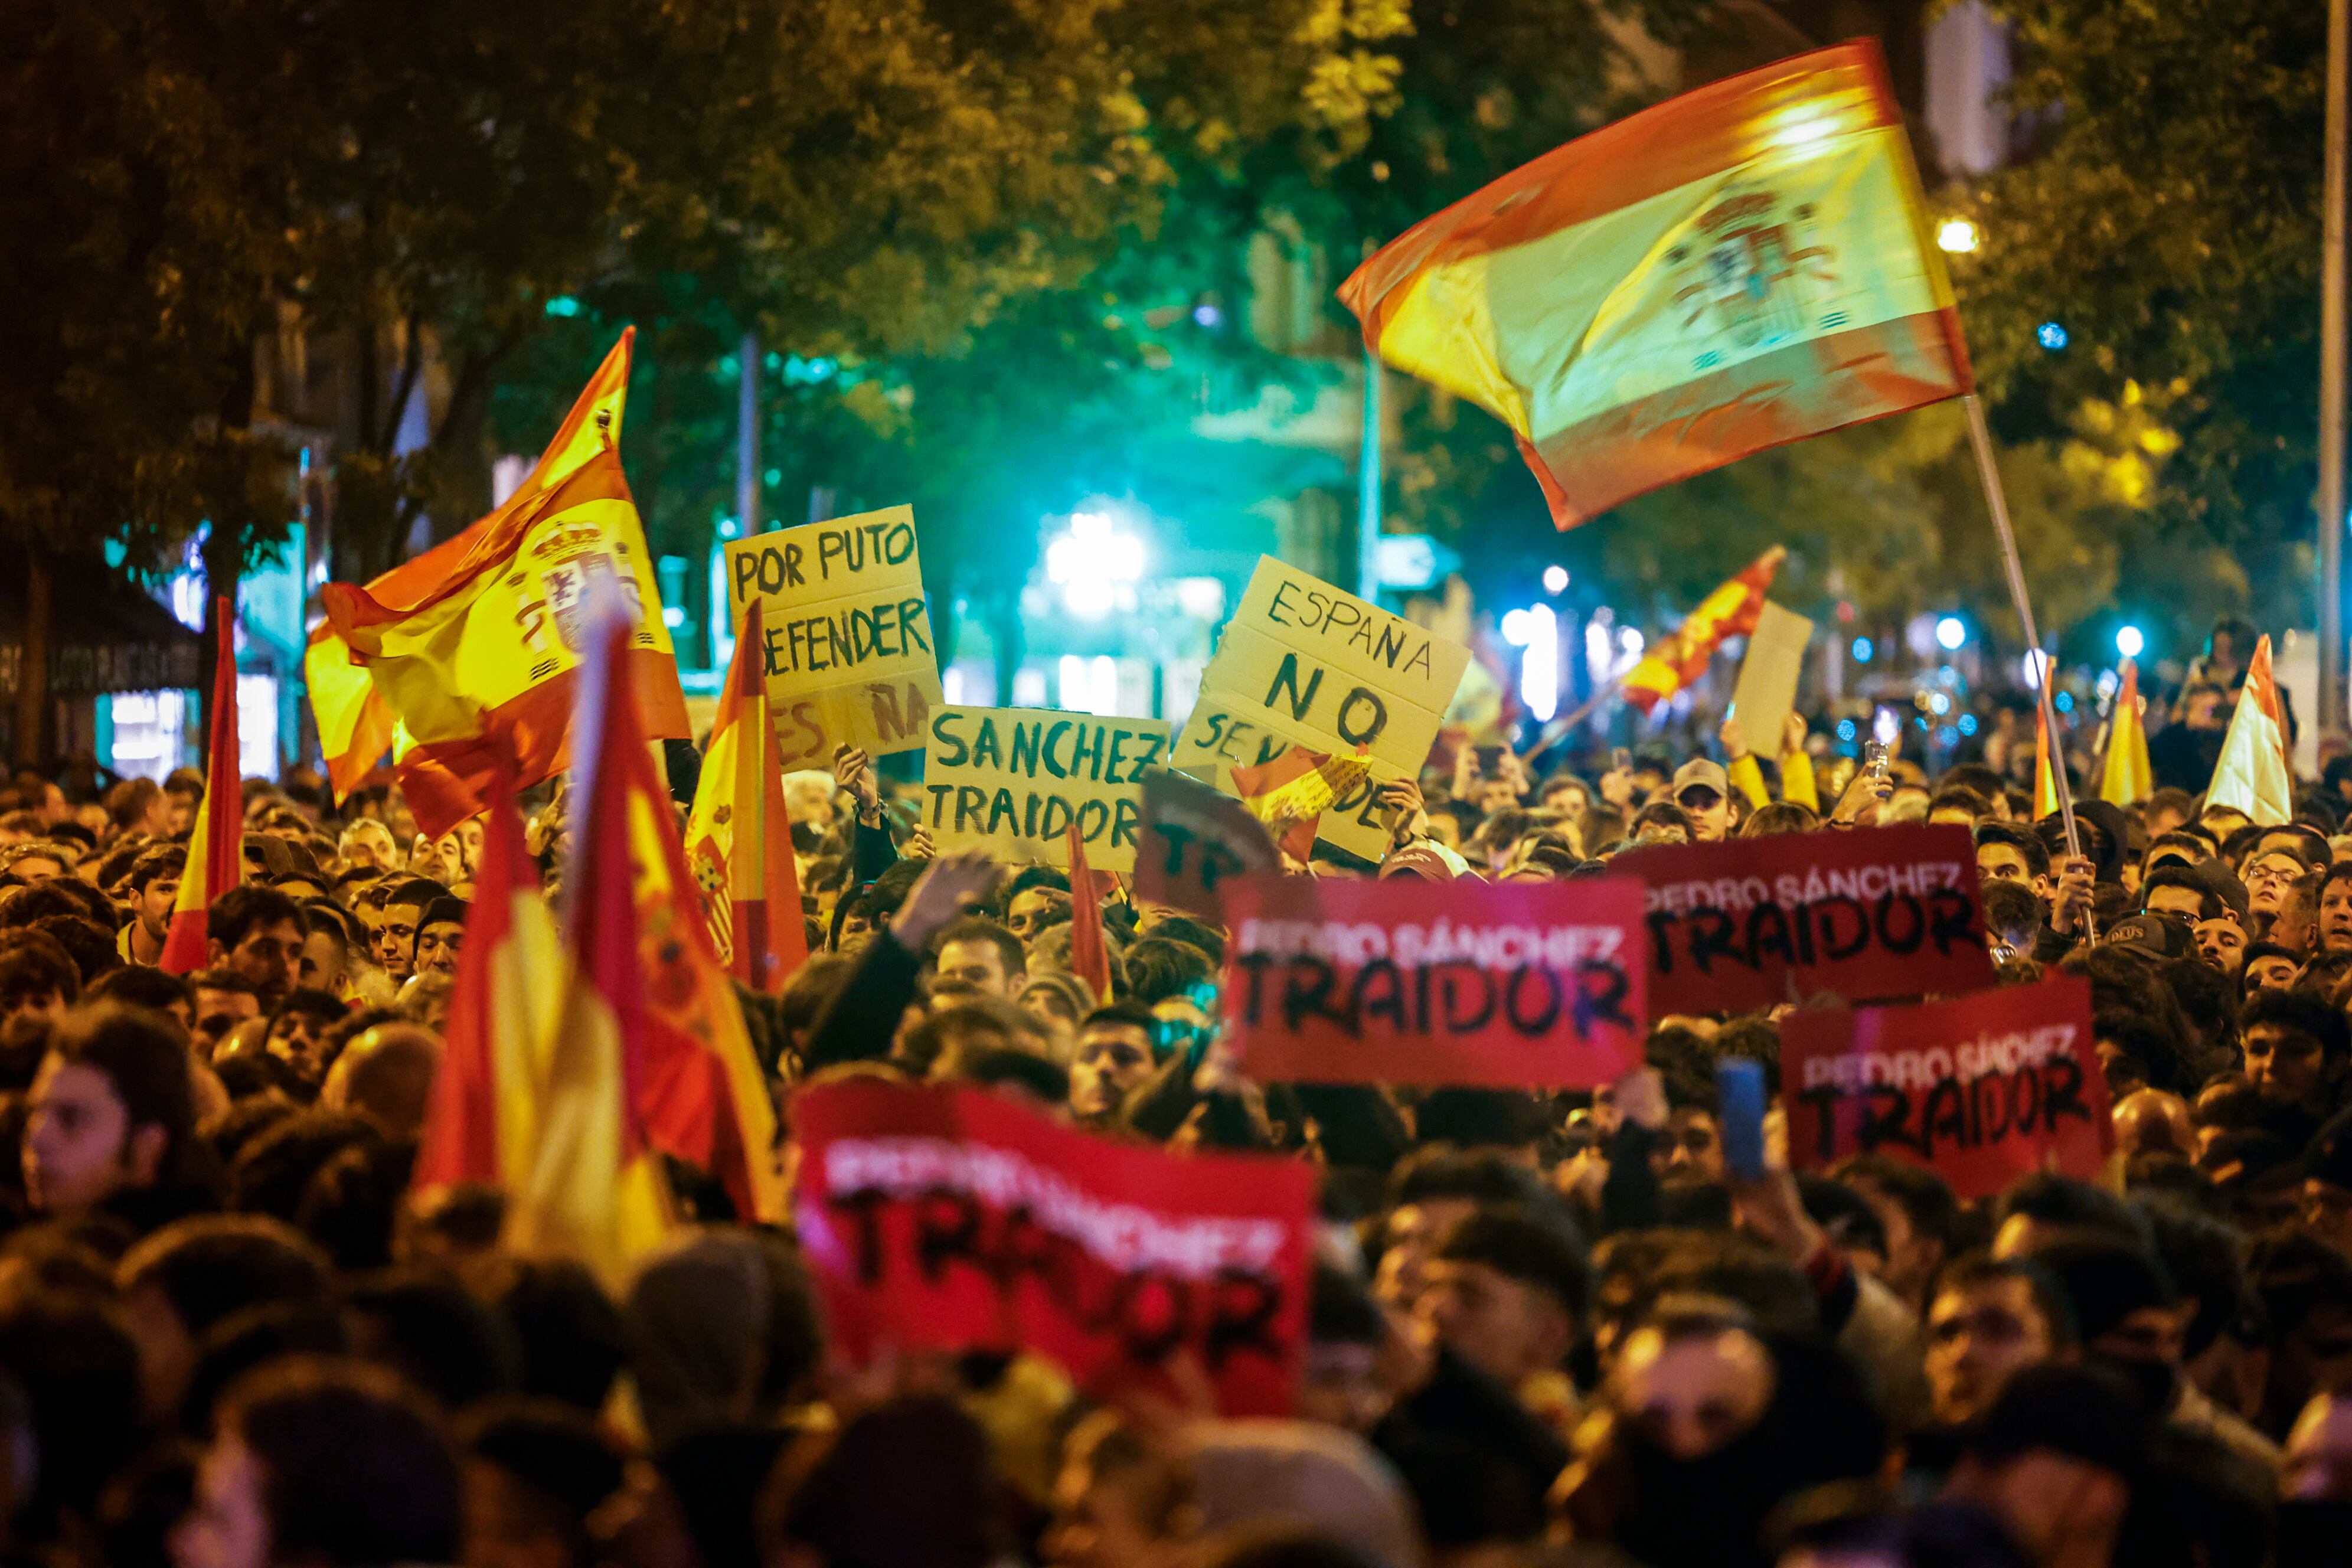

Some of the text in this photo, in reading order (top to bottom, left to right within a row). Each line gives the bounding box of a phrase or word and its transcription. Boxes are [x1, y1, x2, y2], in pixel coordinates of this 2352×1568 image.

[735, 522, 915, 603] POR PUTO
[1268, 580, 1430, 681] ESPAÑA
[1264, 652, 1388, 746] NO
[932, 712, 1167, 785] SANCHEZ
[927, 784, 1141, 848] TRAIDOR
[1645, 887, 1986, 975] TRAIDOR
[2111, 925, 2145, 943] DEUS
[1237, 950, 1638, 1043] TRAIDOR
[1798, 1053, 2092, 1160] TRAIDOR
